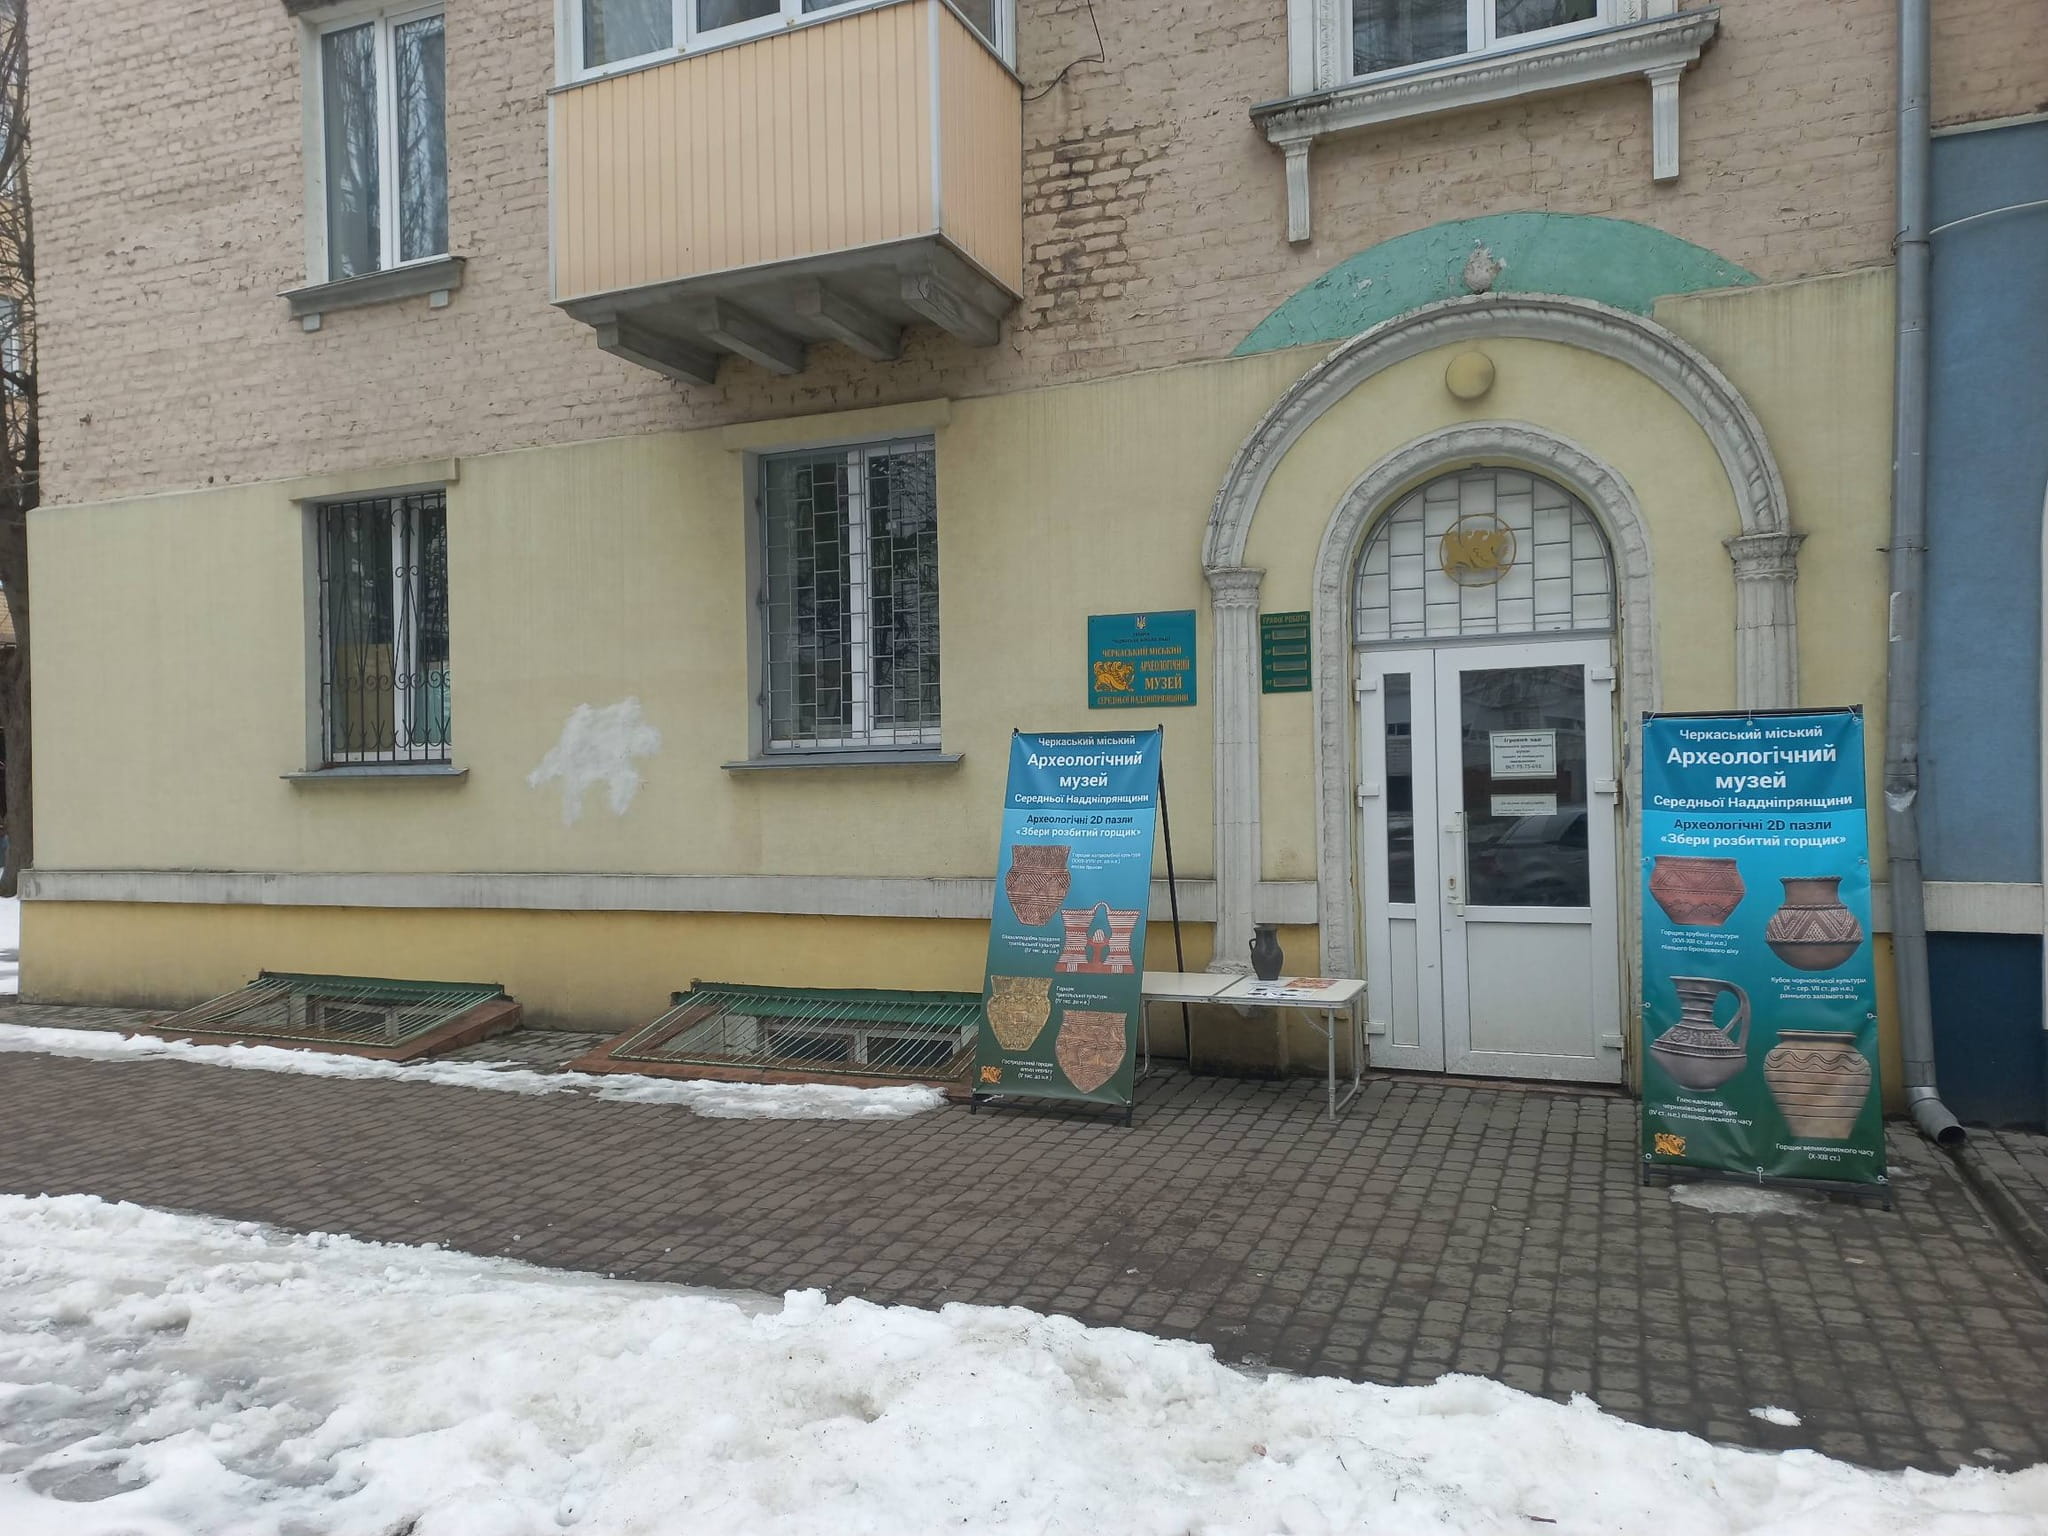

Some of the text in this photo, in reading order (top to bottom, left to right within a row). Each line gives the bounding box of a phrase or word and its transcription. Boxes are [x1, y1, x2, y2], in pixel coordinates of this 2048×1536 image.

[1145, 673, 1182, 690] МУЗЕЙ
[1038, 735, 1136, 748] Черкаський міський
[1680, 726, 1823, 742] Черкаський міський
[1027, 751, 1143, 769] Археологічний
[1667, 744, 1836, 767] Археологічний
[1059, 773, 1108, 790] музей
[1716, 771, 1787, 793] музей
[1014, 794, 1149, 805] Середньої Наддніпрянщини
[1654, 795, 1853, 810] Середньої Наддніпрянщини
[1027, 815, 1133, 825] Археологічні 2D пазли
[1674, 819, 1832, 832] Археологічні 2D пазли
[1016, 827, 1141, 838] «Збери розбитий горщик»
[1660, 833, 1846, 848] «Збери розбитий горщик»
